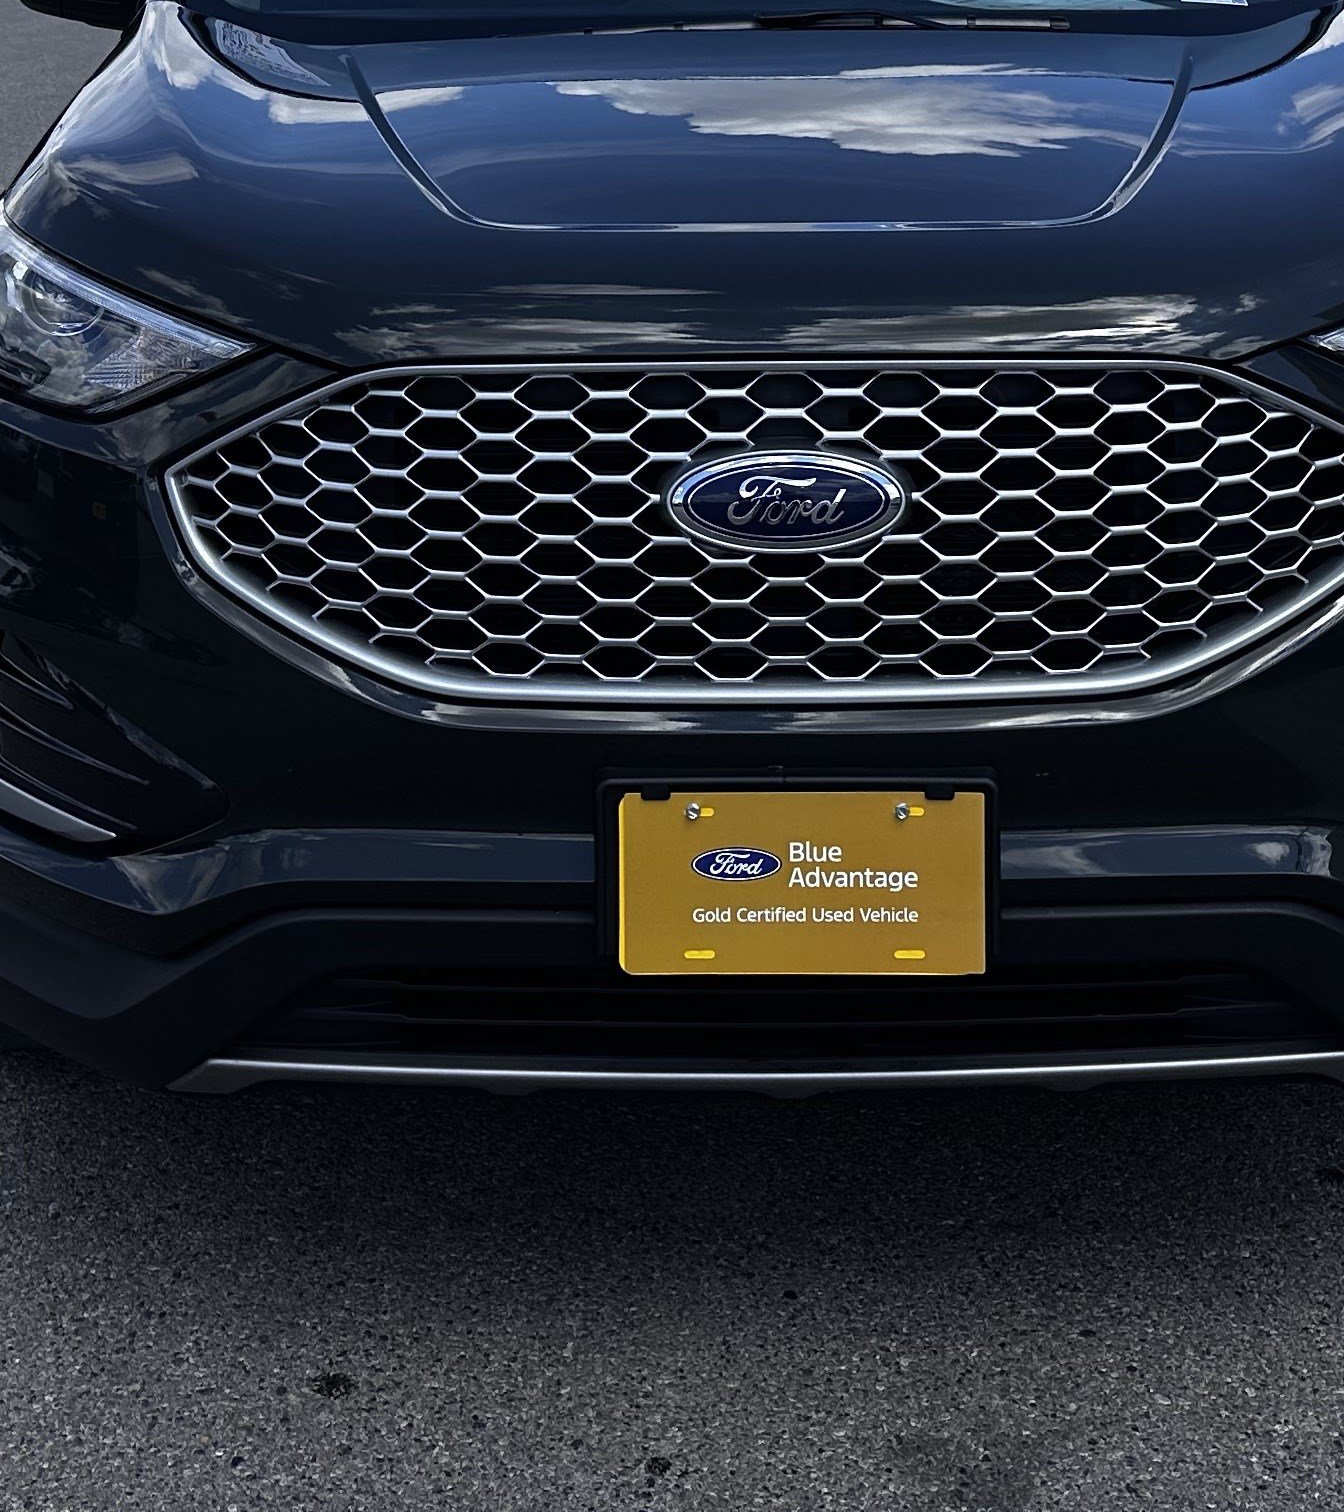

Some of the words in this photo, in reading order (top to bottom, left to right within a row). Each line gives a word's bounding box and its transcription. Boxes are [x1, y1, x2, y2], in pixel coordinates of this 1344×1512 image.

[727, 475, 847, 525] Ford
[709, 852, 764, 875] Ford
[788, 841, 842, 863] Blue
[788, 867, 919, 892] Advantage
[692, 907, 731, 923] Gold
[736, 907, 807, 923] Certified
[812, 907, 854, 923] Used
[859, 907, 919, 923] Vehicle
